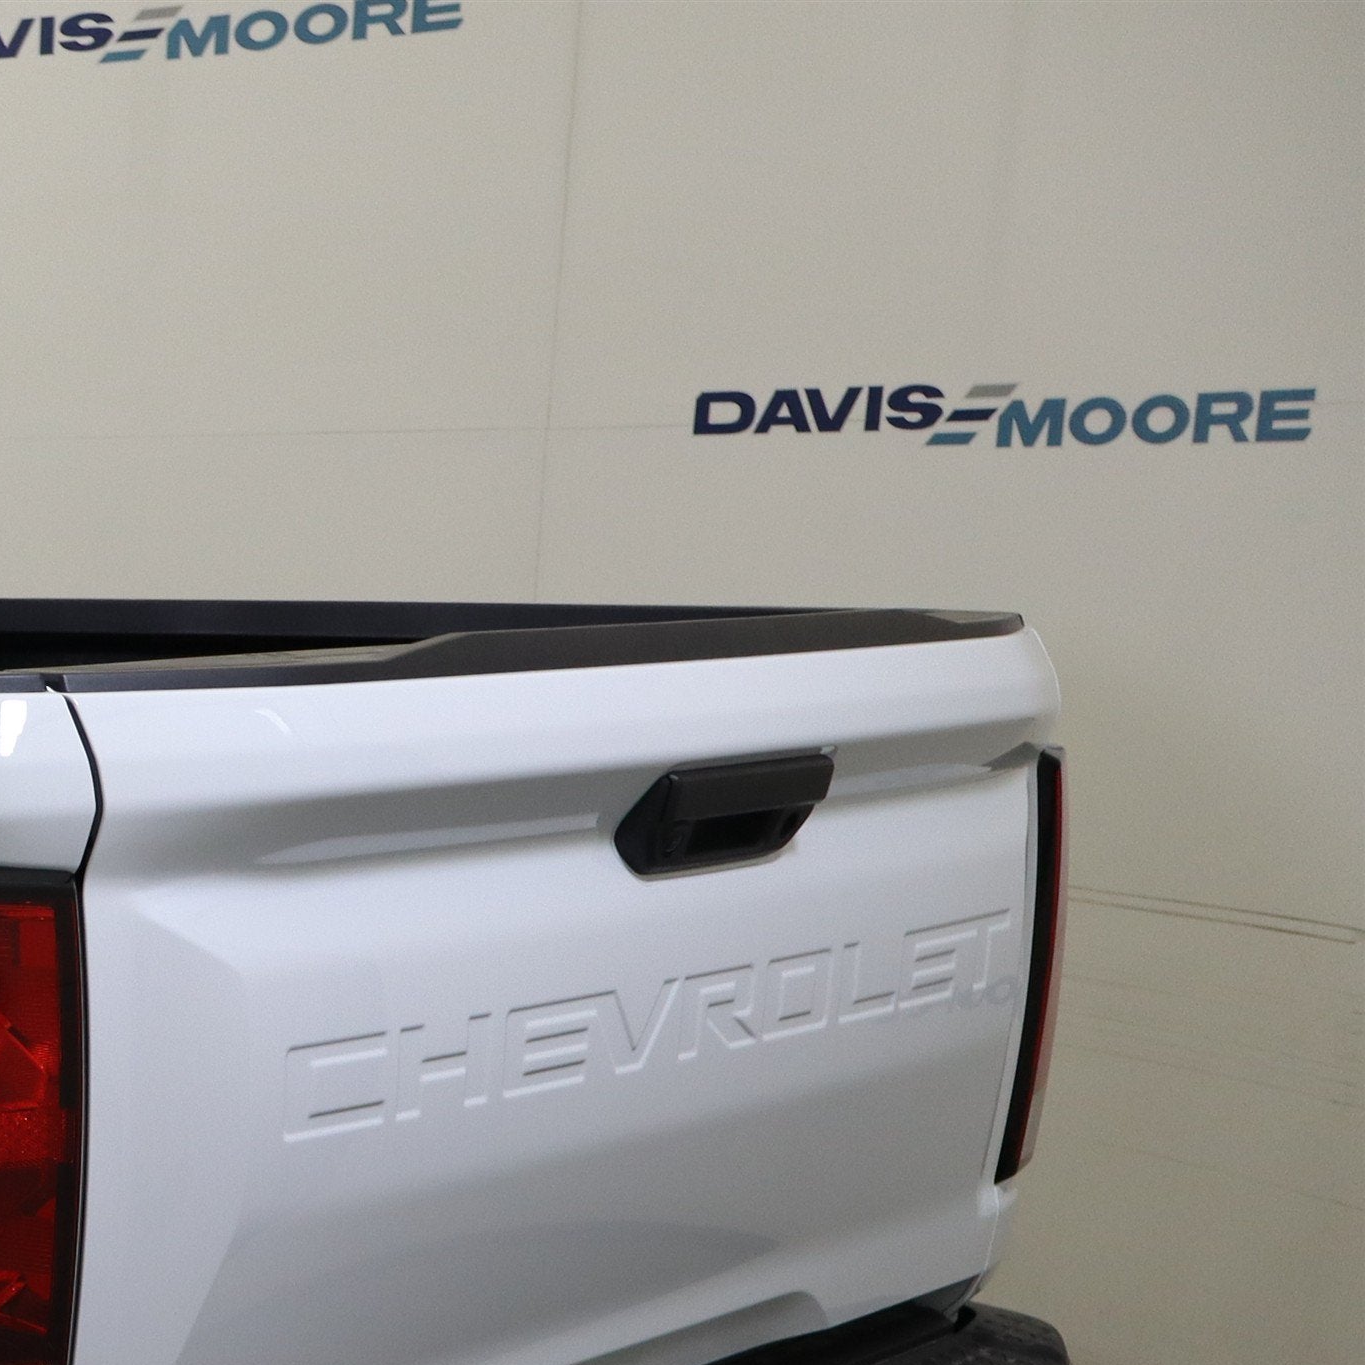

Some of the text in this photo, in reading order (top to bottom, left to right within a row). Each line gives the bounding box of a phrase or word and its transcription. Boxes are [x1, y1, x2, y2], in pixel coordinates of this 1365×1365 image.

[166, 0, 465, 61] MOORE
[692, 383, 1317, 449] DAVIS MOORE
[282, 907, 1011, 1142] CHEVROLET
